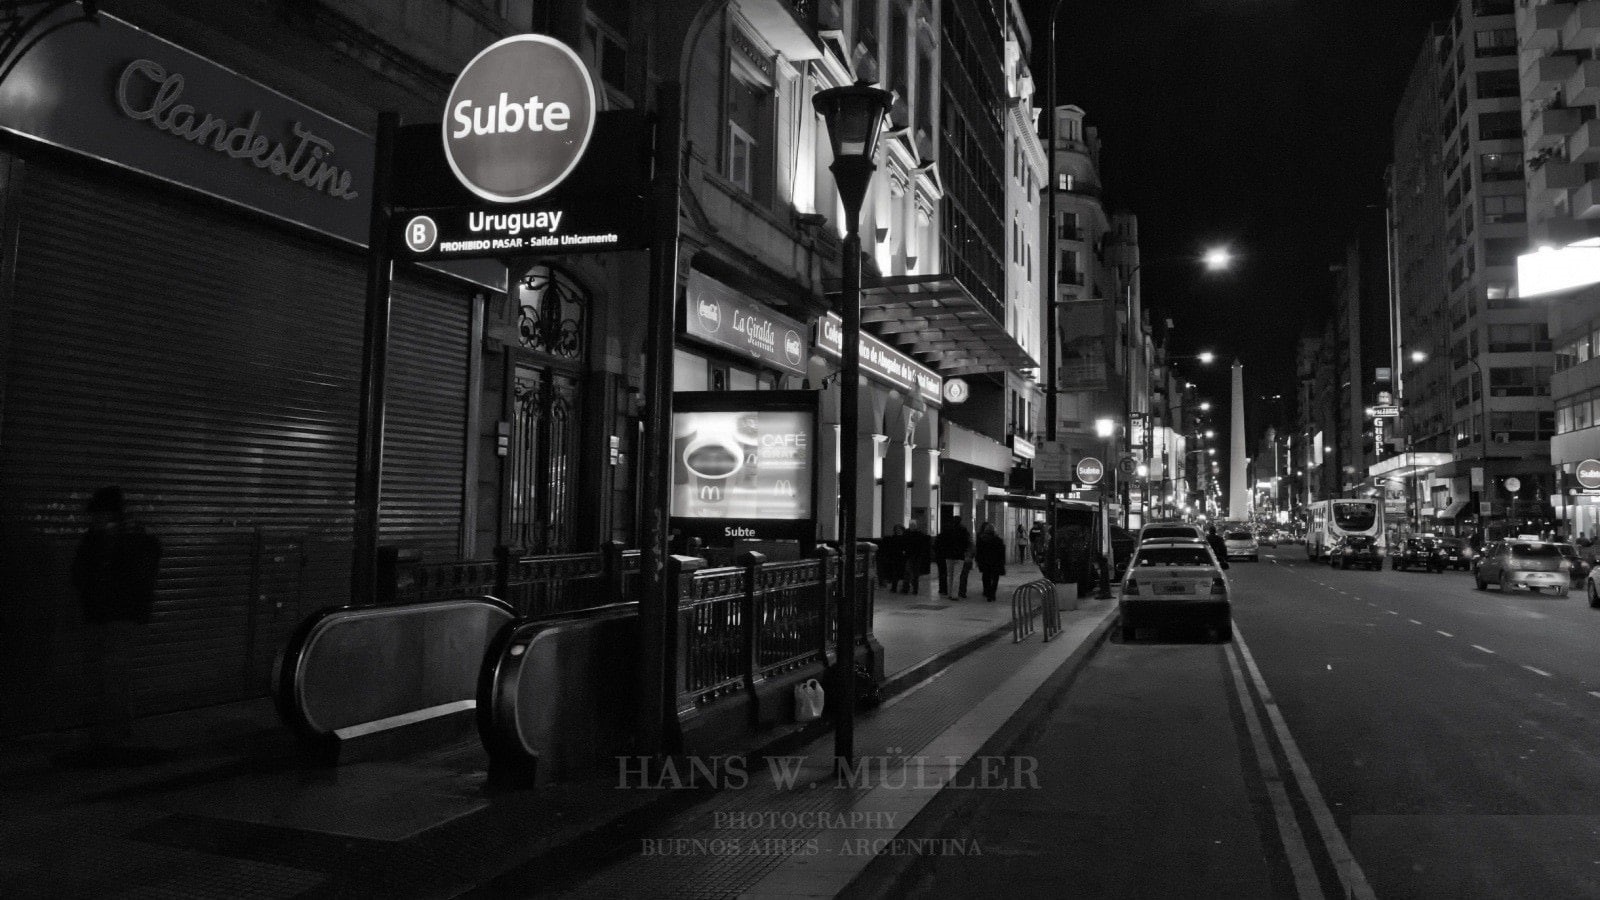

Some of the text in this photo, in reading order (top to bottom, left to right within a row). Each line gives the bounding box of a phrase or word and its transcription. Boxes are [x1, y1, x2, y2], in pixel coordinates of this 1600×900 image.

[453, 92, 571, 139] Subte
[469, 210, 563, 235] Uruguay
[412, 223, 426, 245] B
[439, 240, 490, 252] PROHIBIDO
[492, 238, 523, 249] PASAR
[530, 236, 559, 247] Salida
[561, 233, 618, 246] Unicamente
[732, 309, 775, 346] La Giralda
[824, 321, 843, 350] Coleg
[761, 431, 808, 448] CAFÉ
[1079, 467, 1100, 476] Subte
[724, 526, 756, 537] Subte
